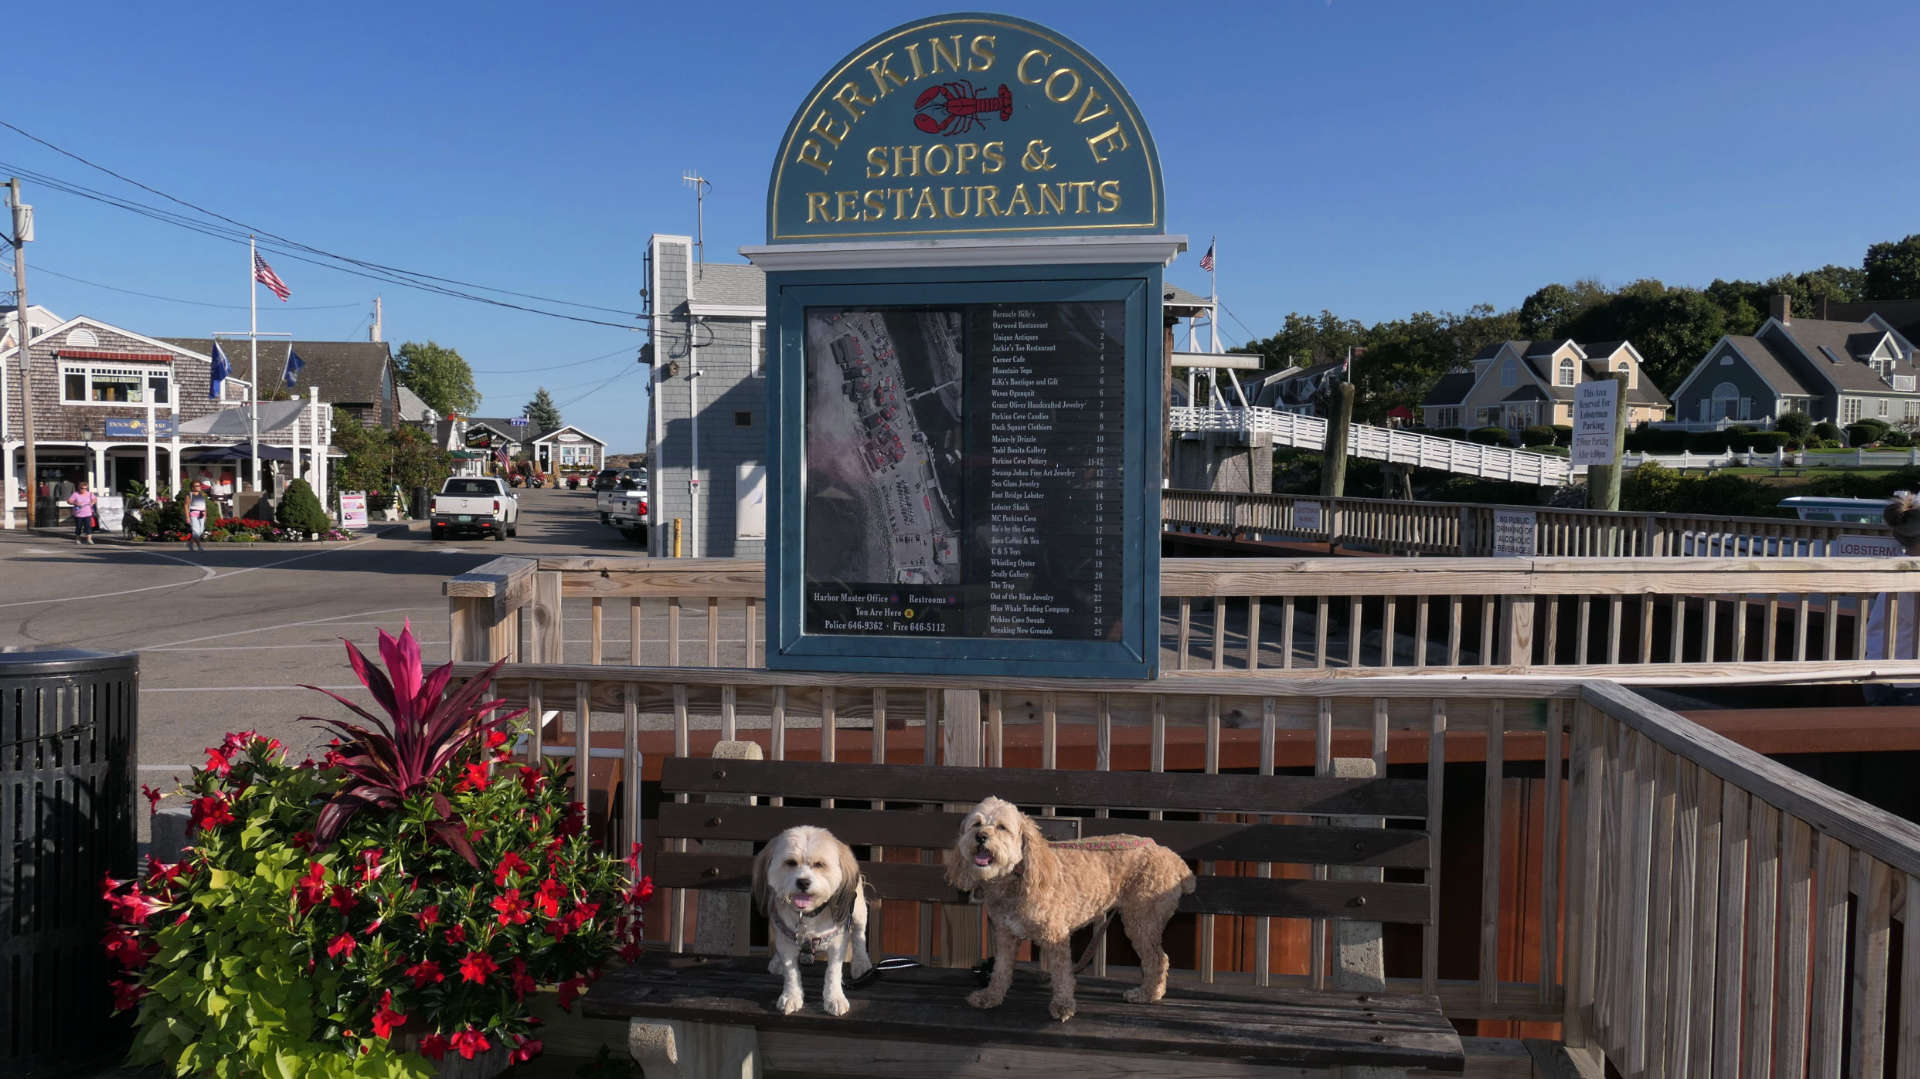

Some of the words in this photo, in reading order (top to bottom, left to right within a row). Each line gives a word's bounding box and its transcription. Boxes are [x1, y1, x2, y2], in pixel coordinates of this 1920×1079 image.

[796, 34, 997, 176] PERKINS
[1017, 48, 1133, 164] COVE
[866, 140, 1006, 178] SHOPS
[1021, 139, 1057, 172] &
[805, 179, 1123, 224] RESTAURANTS
[994, 334, 1012, 342] Unique
[1014, 333, 1038, 342] Antiques
[1007, 424, 1026, 432] Square
[1583, 421, 1605, 431] Parking
[1026, 446, 1046, 455] Gallery
[1019, 480, 1039, 489] Jewelry
[1509, 516, 1530, 525] PUBLIC
[1496, 525, 1523, 534] DRINKING
[1498, 536, 1530, 544] ALCOHOLIC
[1840, 544, 1896, 556] LOBSTERM
[1002, 582, 1015, 590] Trap
[814, 593, 839, 602] Harbor
[841, 593, 865, 602] Master
[866, 593, 888, 603] Office
[909, 595, 946, 604] Restrooms
[1032, 594, 1054, 602] Jewelry
[856, 608, 869, 616] You
[870, 608, 882, 616] Are
[885, 608, 901, 617] Here
[1023, 605, 1043, 614] Trading
[1045, 605, 1070, 614] Company
[825, 620, 846, 630] Police
[894, 622, 908, 631] Fire
